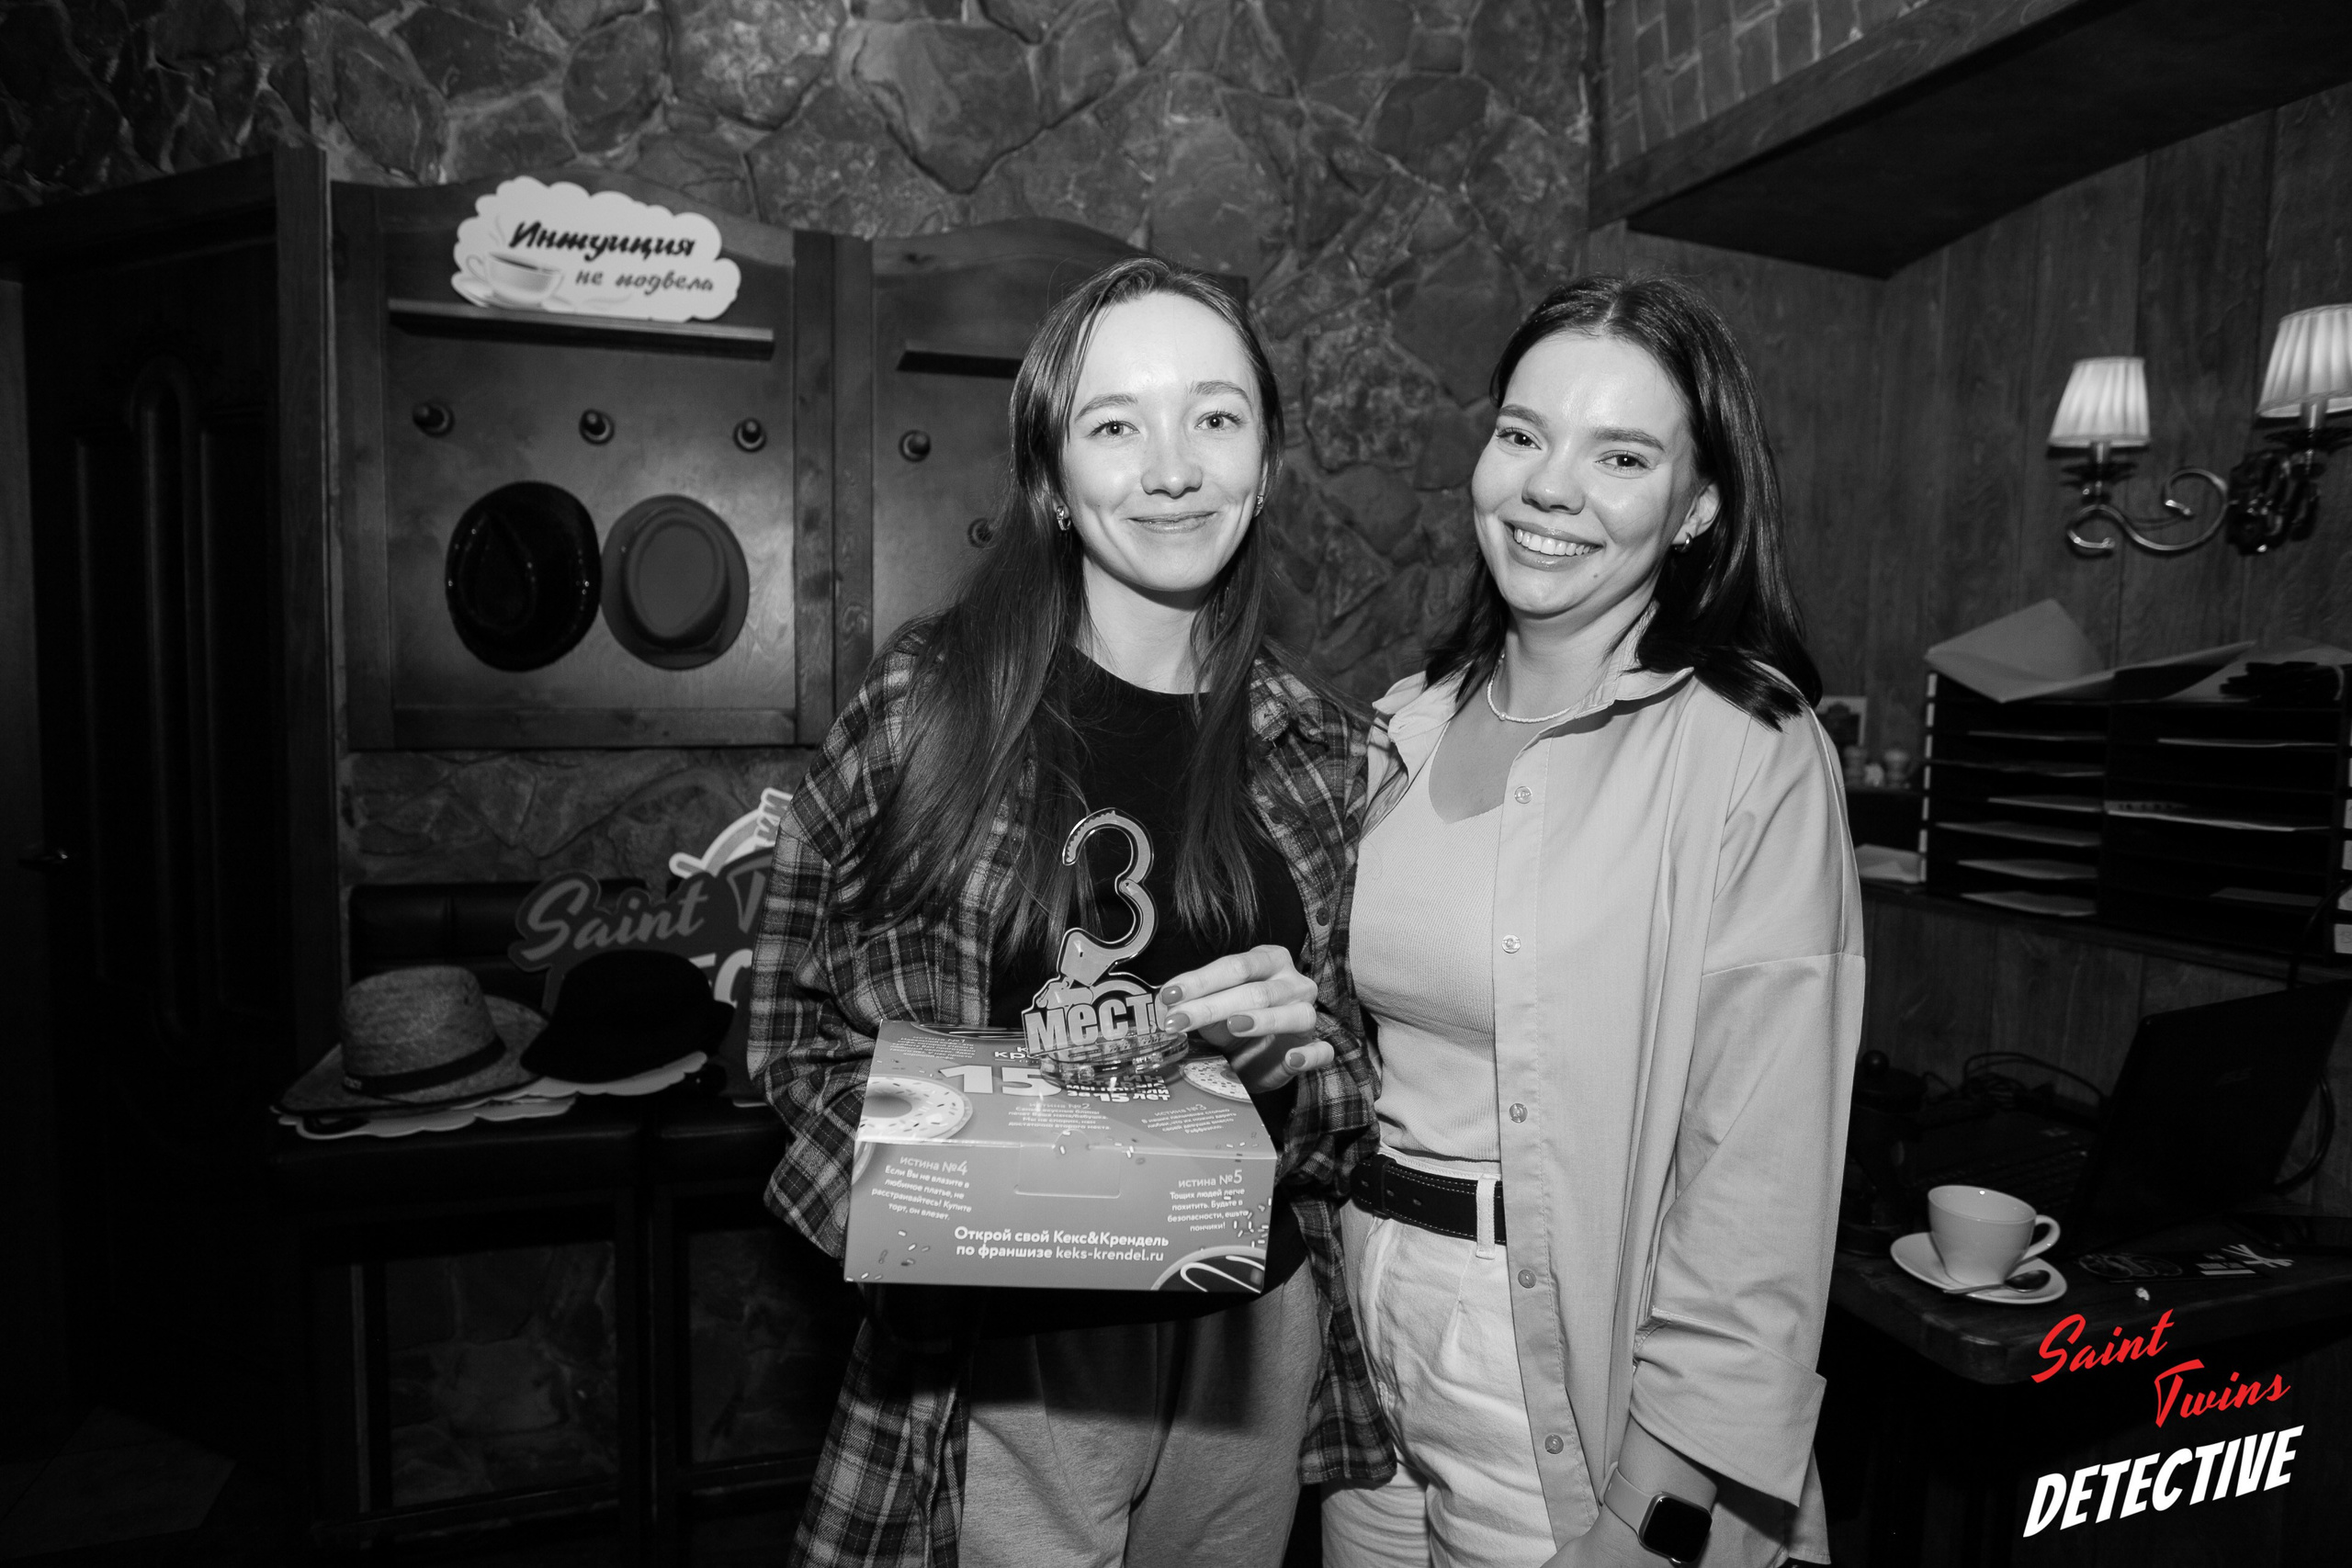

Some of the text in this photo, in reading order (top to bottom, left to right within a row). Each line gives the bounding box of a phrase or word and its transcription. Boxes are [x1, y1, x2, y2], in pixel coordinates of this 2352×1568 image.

[509, 220, 695, 262] Интуиция
[575, 269, 713, 296] не подвела
[521, 880, 707, 960] Saint
[939, 1065, 1061, 1097] 15
[1093, 1093, 1130, 1102] 15
[885, 1165, 905, 1176] Если
[907, 1169, 919, 1179] Вы
[932, 1176, 963, 1187] влазите
[942, 1160, 968, 1176] №4
[1219, 1168, 1242, 1185] №5
[885, 1179, 923, 1191] любимое
[924, 1186, 953, 1199] платье,
[1170, 1191, 1194, 1200] Тощих
[1196, 1189, 1222, 1198] людей
[871, 1188, 972, 1213] расстраивайтесь! Купите
[1211, 1200, 1237, 1209] Будьте
[888, 1202, 908, 1213] торт,
[921, 1210, 950, 1220] влезет.
[1167, 1213, 1224, 1223] безопасности,
[954, 1225, 1170, 1247] Открой свой Кекс&Крендель
[1190, 1221, 1226, 1232] пончики!
[956, 1243, 1164, 1262] по франшизе keks-krendel.ru
